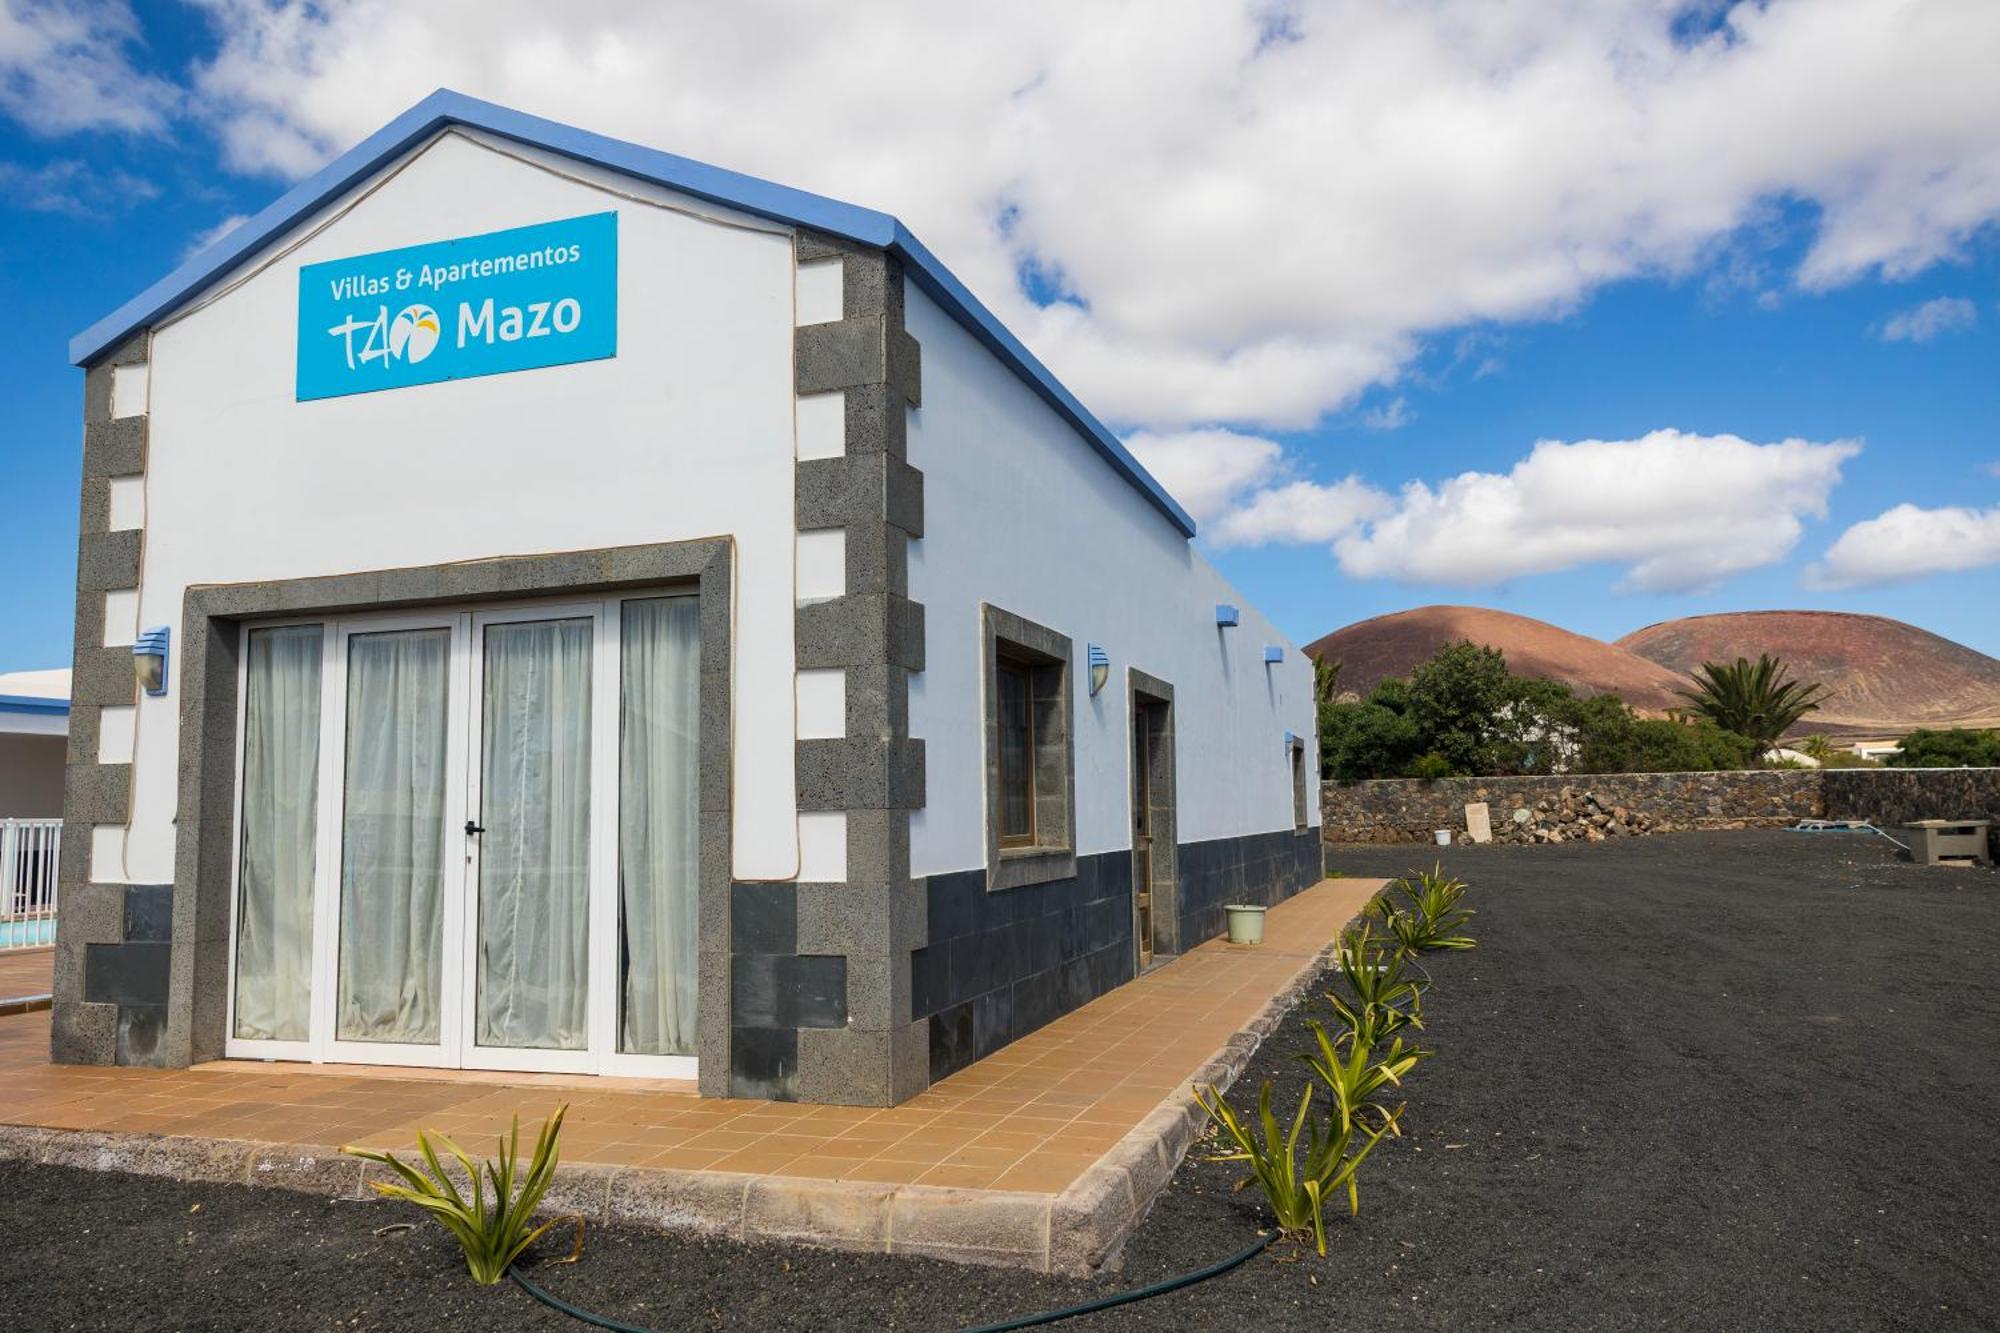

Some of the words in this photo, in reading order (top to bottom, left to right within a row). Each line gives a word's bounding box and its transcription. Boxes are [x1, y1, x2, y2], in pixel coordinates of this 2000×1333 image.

[330, 275, 390, 301] Villas
[395, 268, 413, 291] &
[418, 244, 581, 291] Apartementos
[456, 297, 582, 349] Mazo
